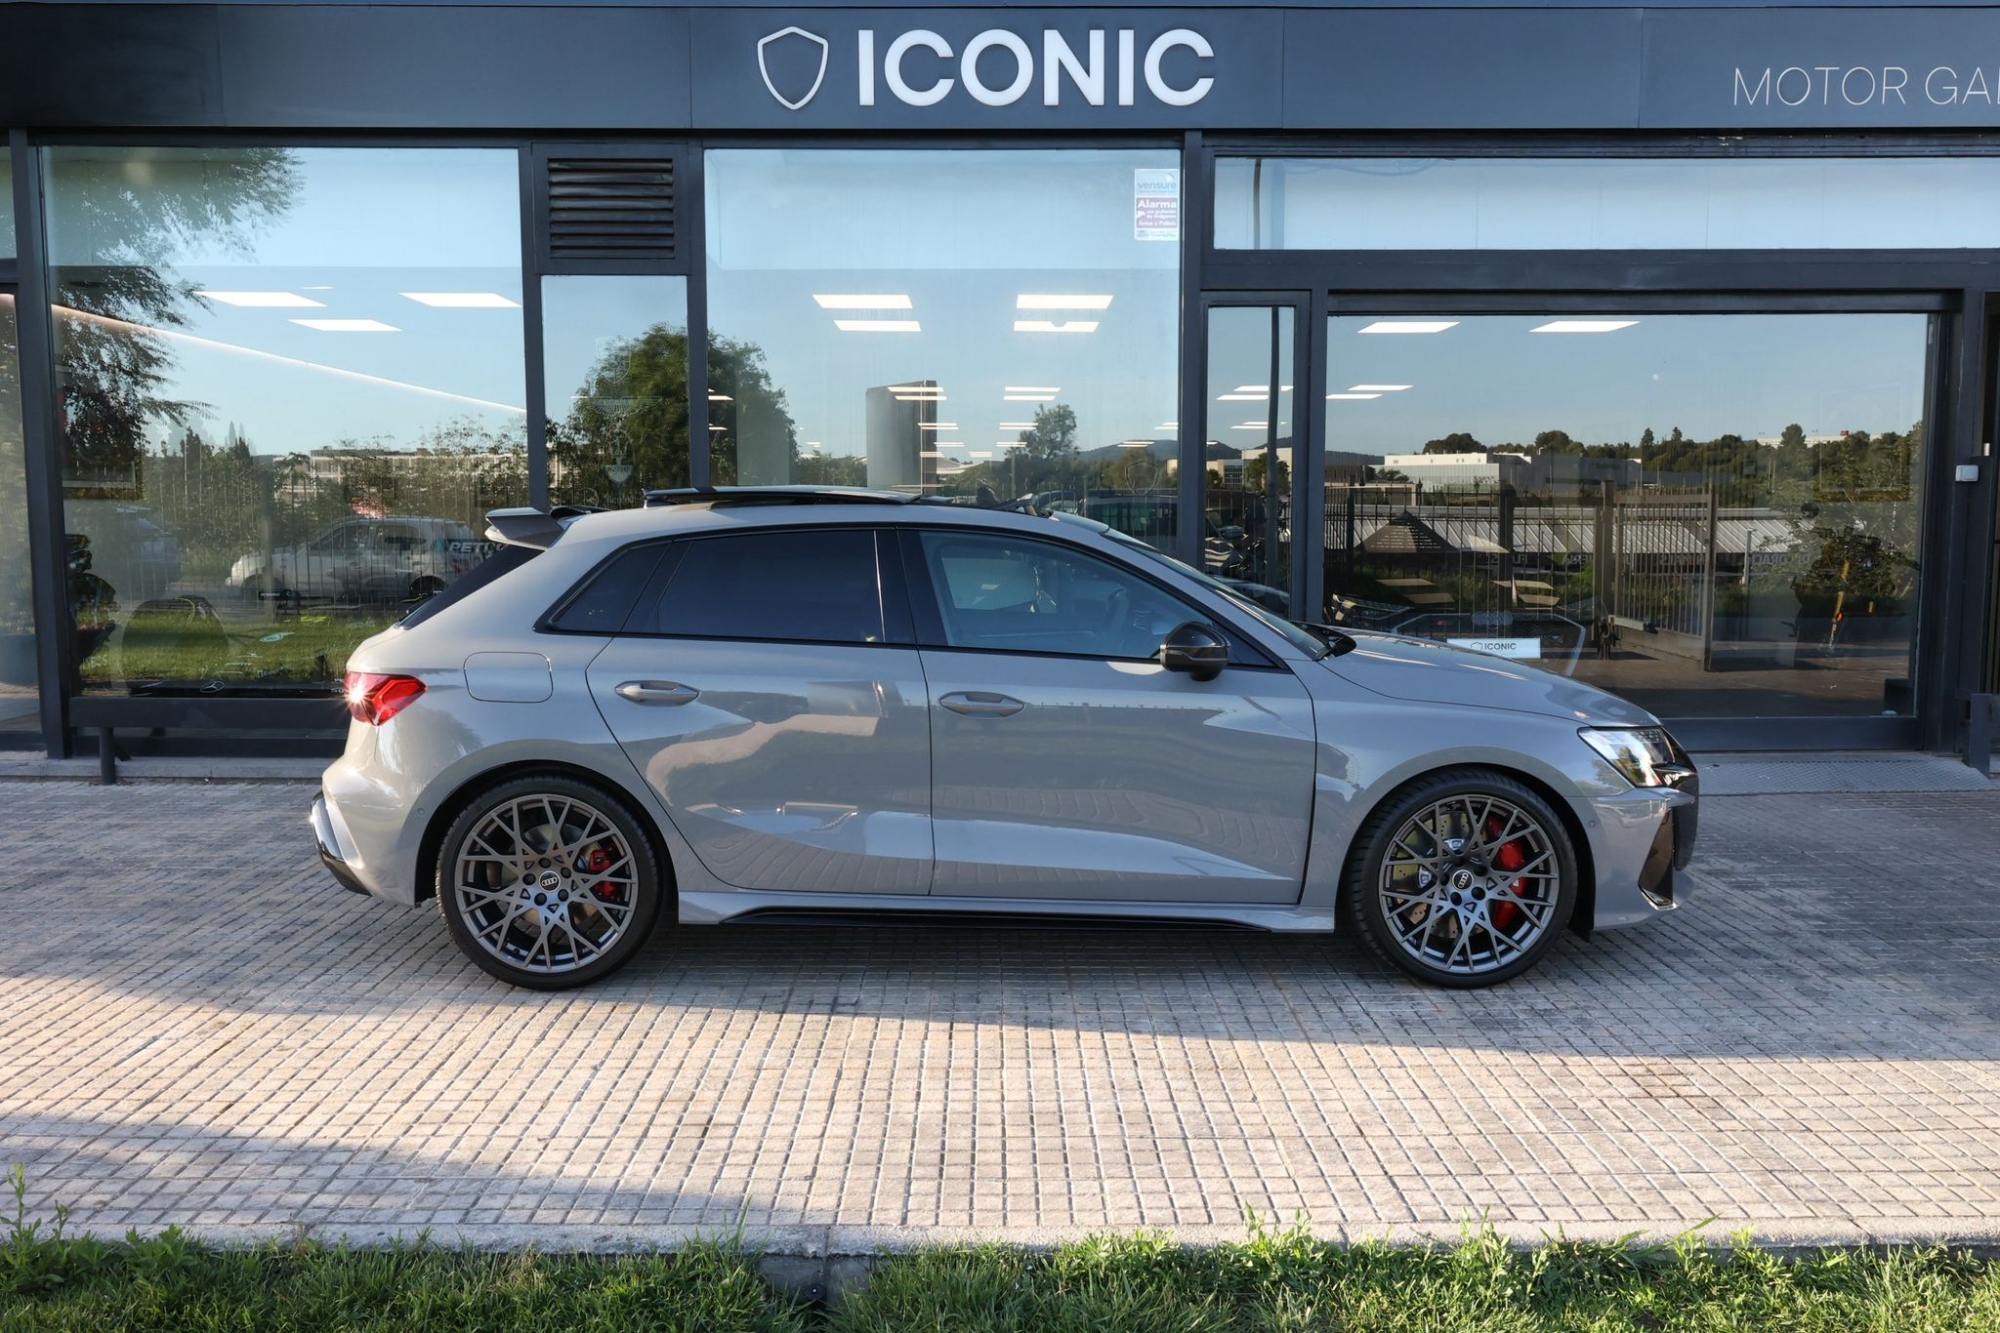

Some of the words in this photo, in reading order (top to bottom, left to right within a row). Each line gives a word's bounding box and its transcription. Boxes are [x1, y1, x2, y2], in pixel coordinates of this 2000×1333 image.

[858, 29, 1215, 107] ICONIC
[1734, 66, 1908, 106] MOTOR
[1137, 199, 1177, 209] Alarma
[1484, 642, 1517, 650] ICONIC
